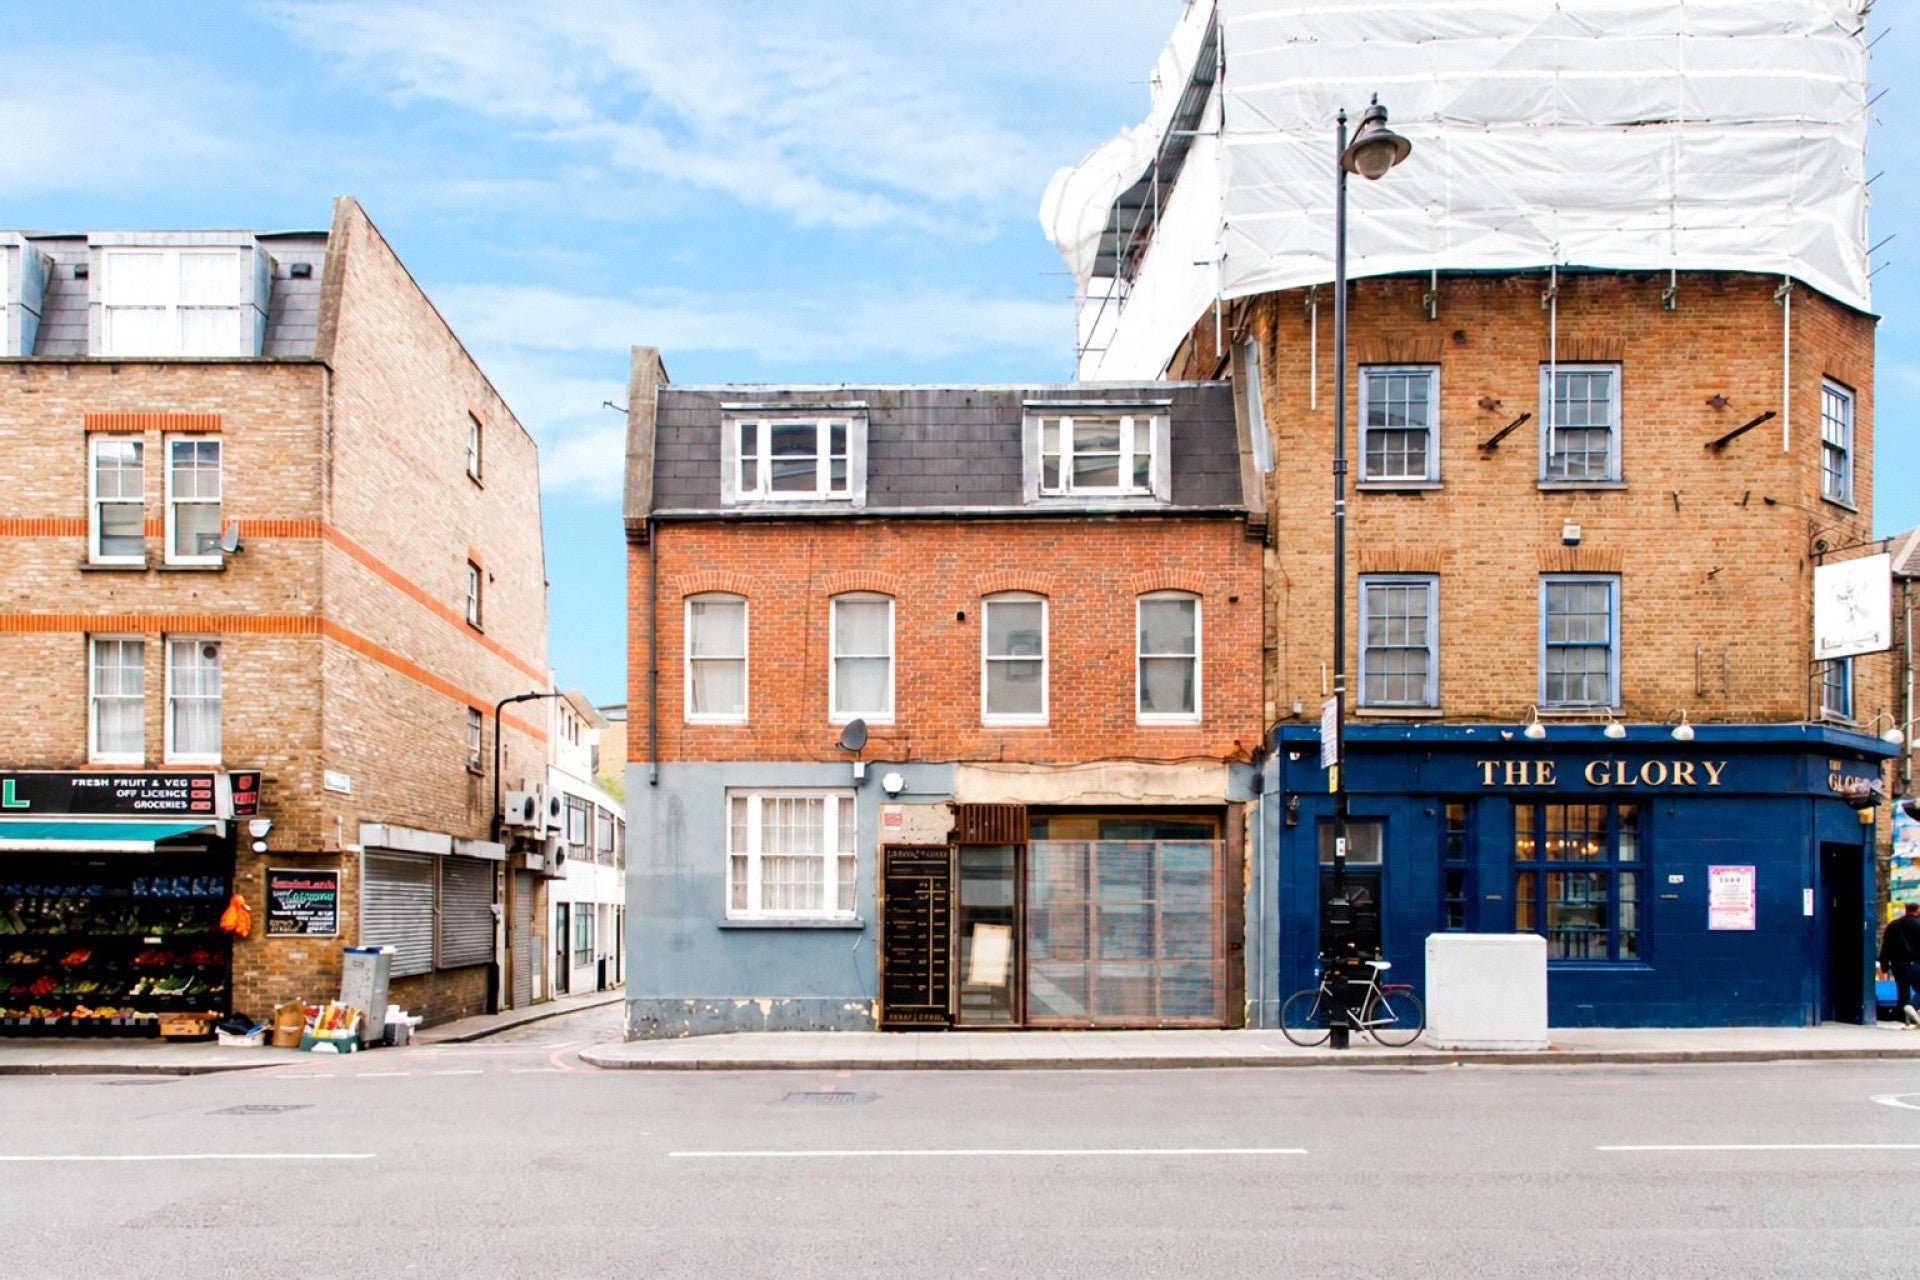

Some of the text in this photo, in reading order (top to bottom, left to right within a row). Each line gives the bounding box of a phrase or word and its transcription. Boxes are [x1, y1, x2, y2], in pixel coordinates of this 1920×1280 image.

[1477, 760, 1728, 786] THE GLORY
[71, 779, 189, 787] FRESH FRUIT & VEG
[116, 789, 188, 798] OFF LICENCE
[133, 800, 188, 810] GROCERIES
